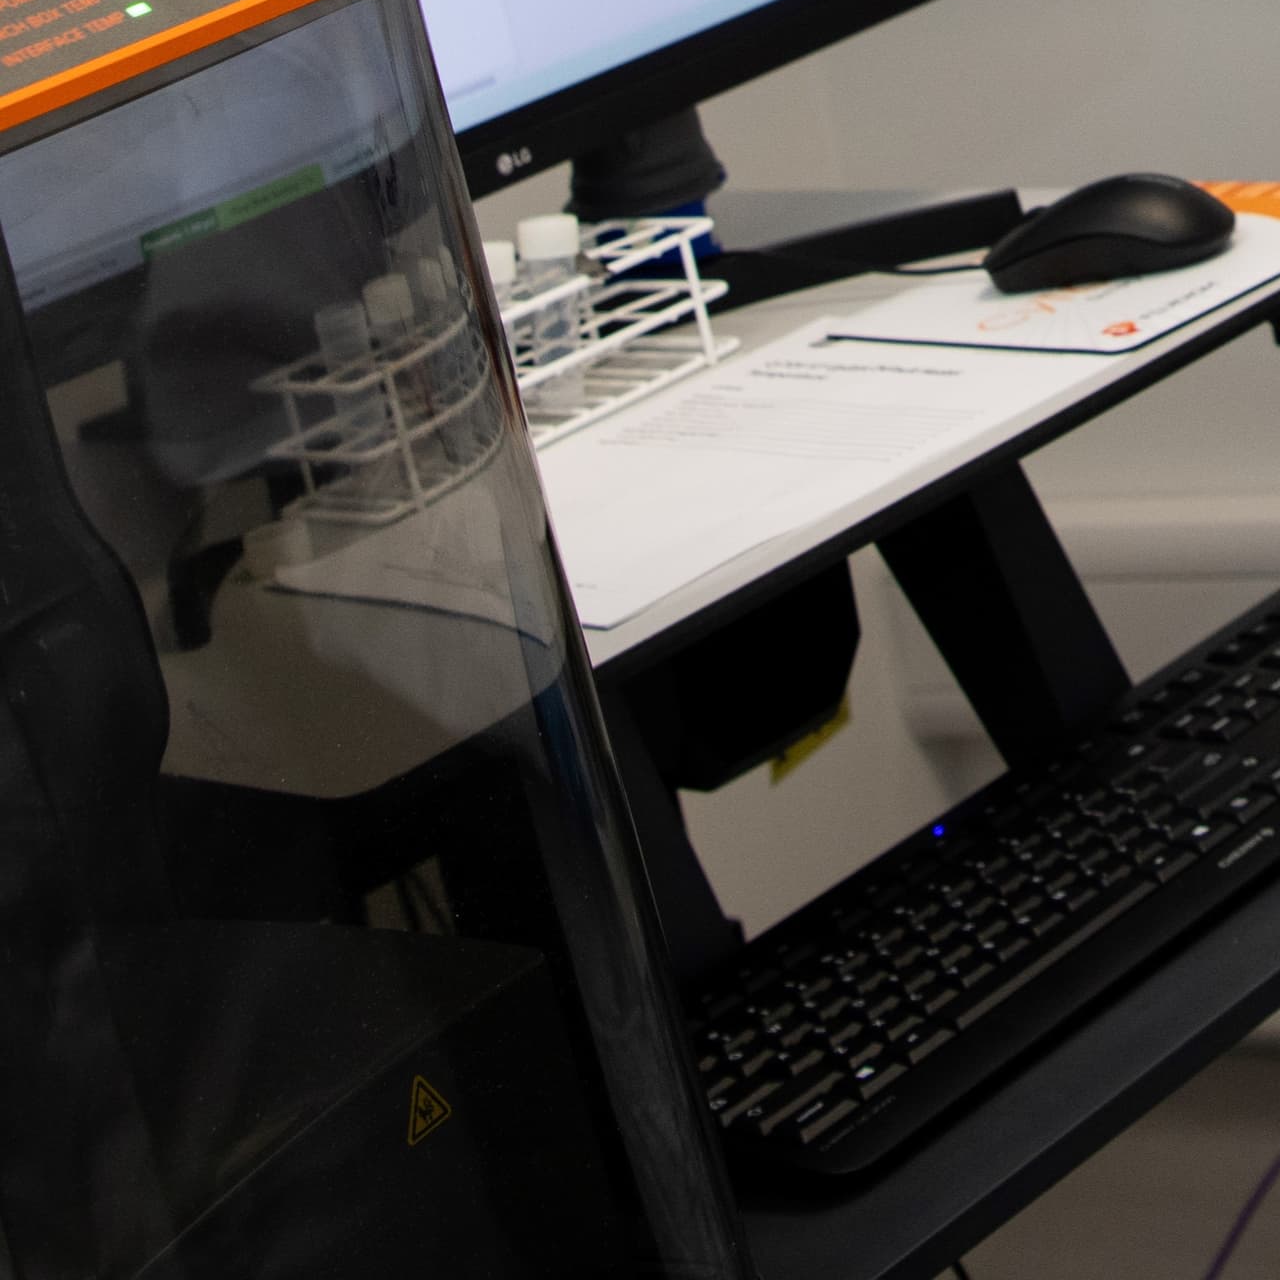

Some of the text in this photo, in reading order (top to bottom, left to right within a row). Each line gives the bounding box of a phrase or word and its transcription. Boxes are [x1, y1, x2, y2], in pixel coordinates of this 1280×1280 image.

[1, 10, 125, 67] INTERFACE TEMP
[511, 147, 532, 167] LG
